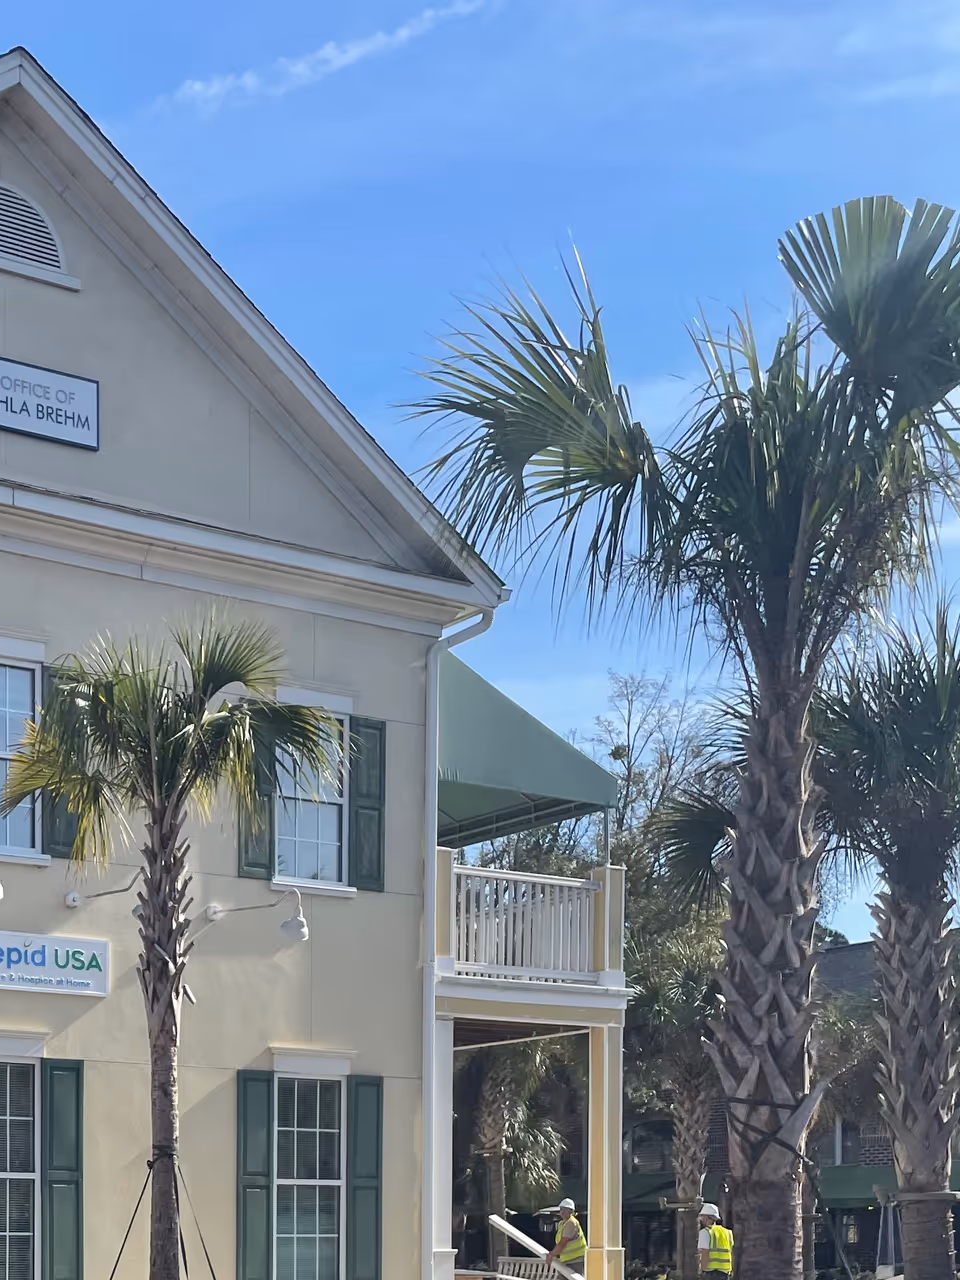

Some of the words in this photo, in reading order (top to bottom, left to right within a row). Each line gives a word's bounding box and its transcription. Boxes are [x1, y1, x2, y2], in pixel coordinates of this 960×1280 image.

[0, 375, 51, 401] OFFICE
[55, 389, 76, 405] OF
[36, 403, 91, 431] BREHM
[54, 948, 102, 972] USA
[9, 974, 16, 982] &
[17, 974, 54, 986] Hospice
[66, 977, 91, 988] Home
